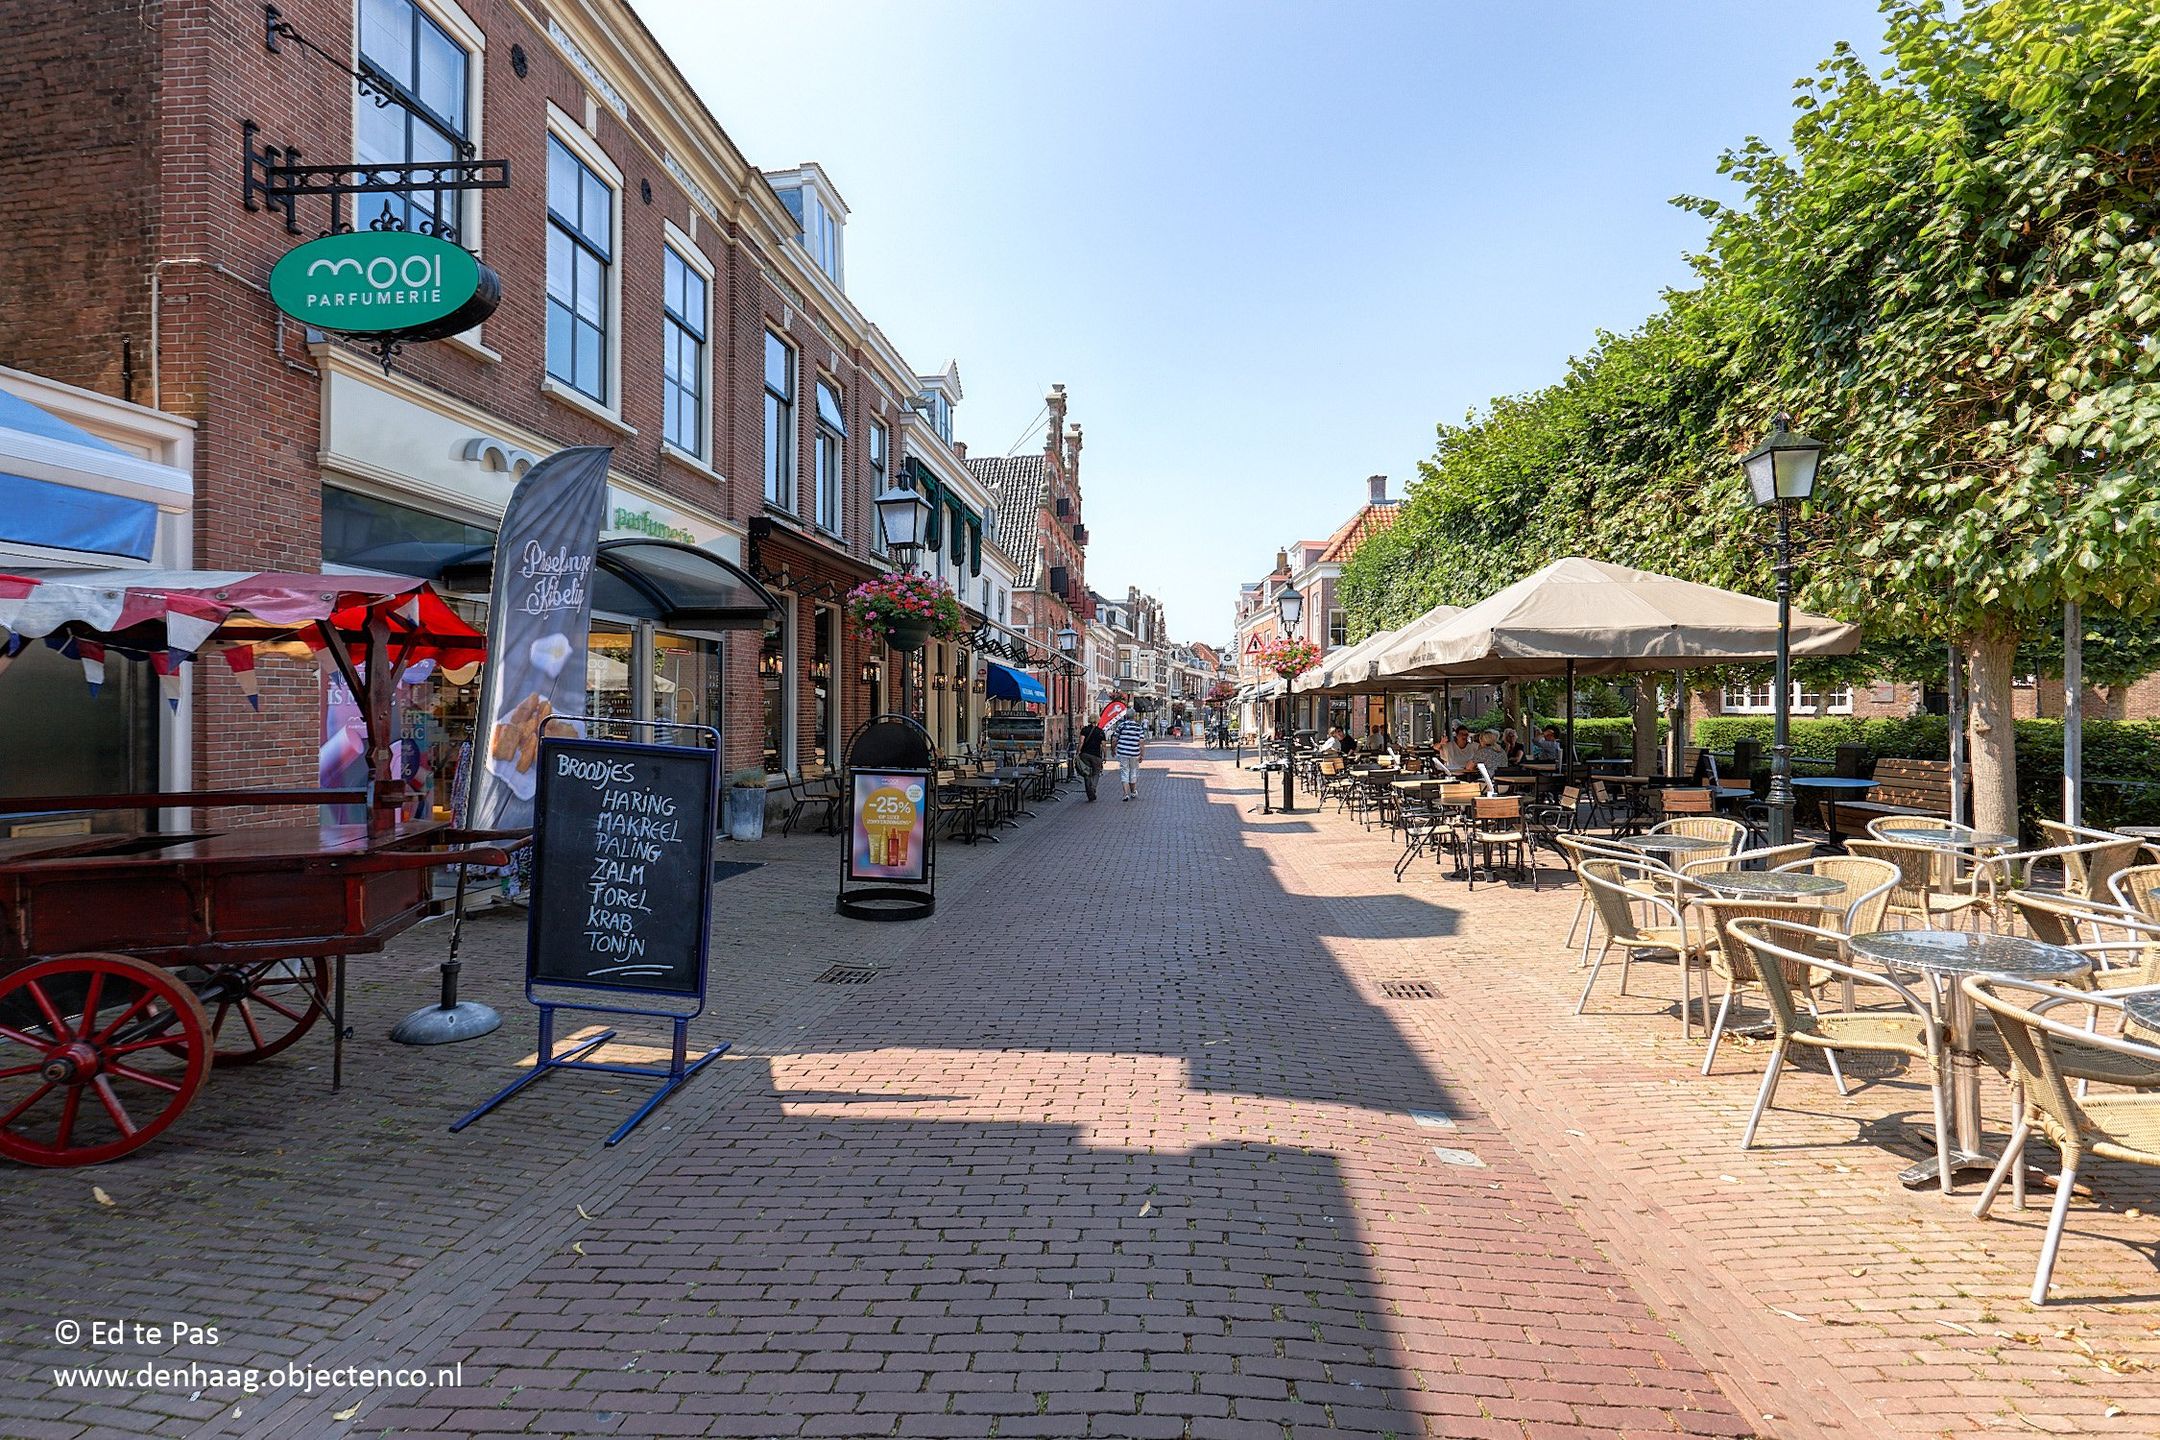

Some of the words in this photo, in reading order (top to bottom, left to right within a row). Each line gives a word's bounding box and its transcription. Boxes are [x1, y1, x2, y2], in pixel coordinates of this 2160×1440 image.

[307, 289, 441, 307] PARFUMERIE
[869, 796, 911, 815] -25%
[596, 812, 682, 843] MAKREEL
[590, 857, 644, 885] ZALM
[588, 883, 652, 914] FOREL
[586, 905, 633, 933] KRAB
